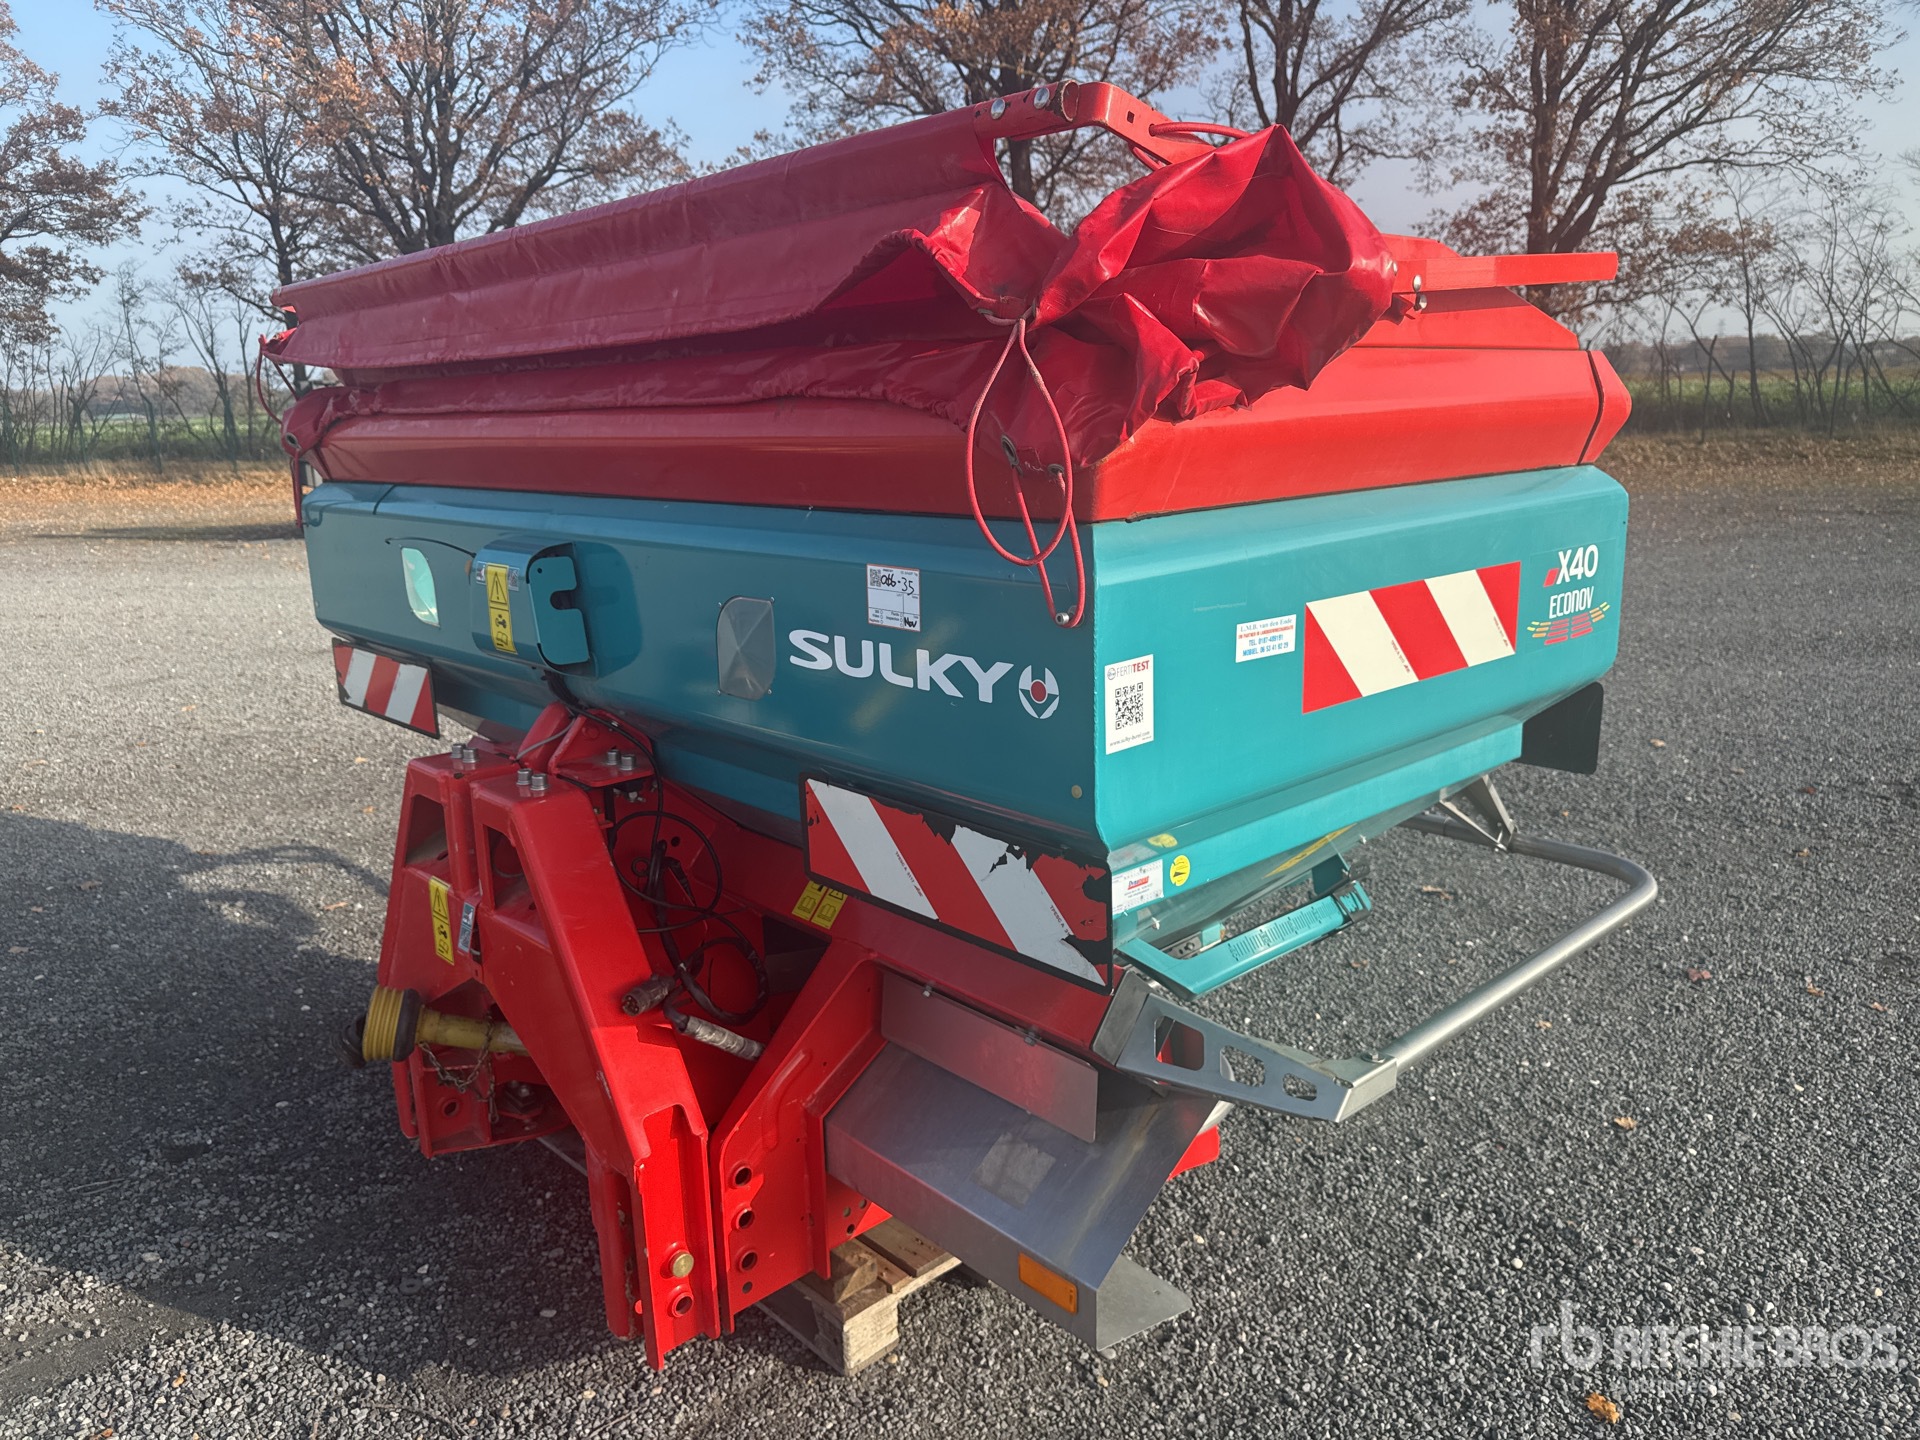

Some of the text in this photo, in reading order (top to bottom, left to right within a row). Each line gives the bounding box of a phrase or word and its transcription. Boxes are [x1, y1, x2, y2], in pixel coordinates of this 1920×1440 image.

[1556, 544, 1599, 585] X40
[788, 629, 1015, 704] SULKY
[1116, 660, 1150, 677] FERTITEST
